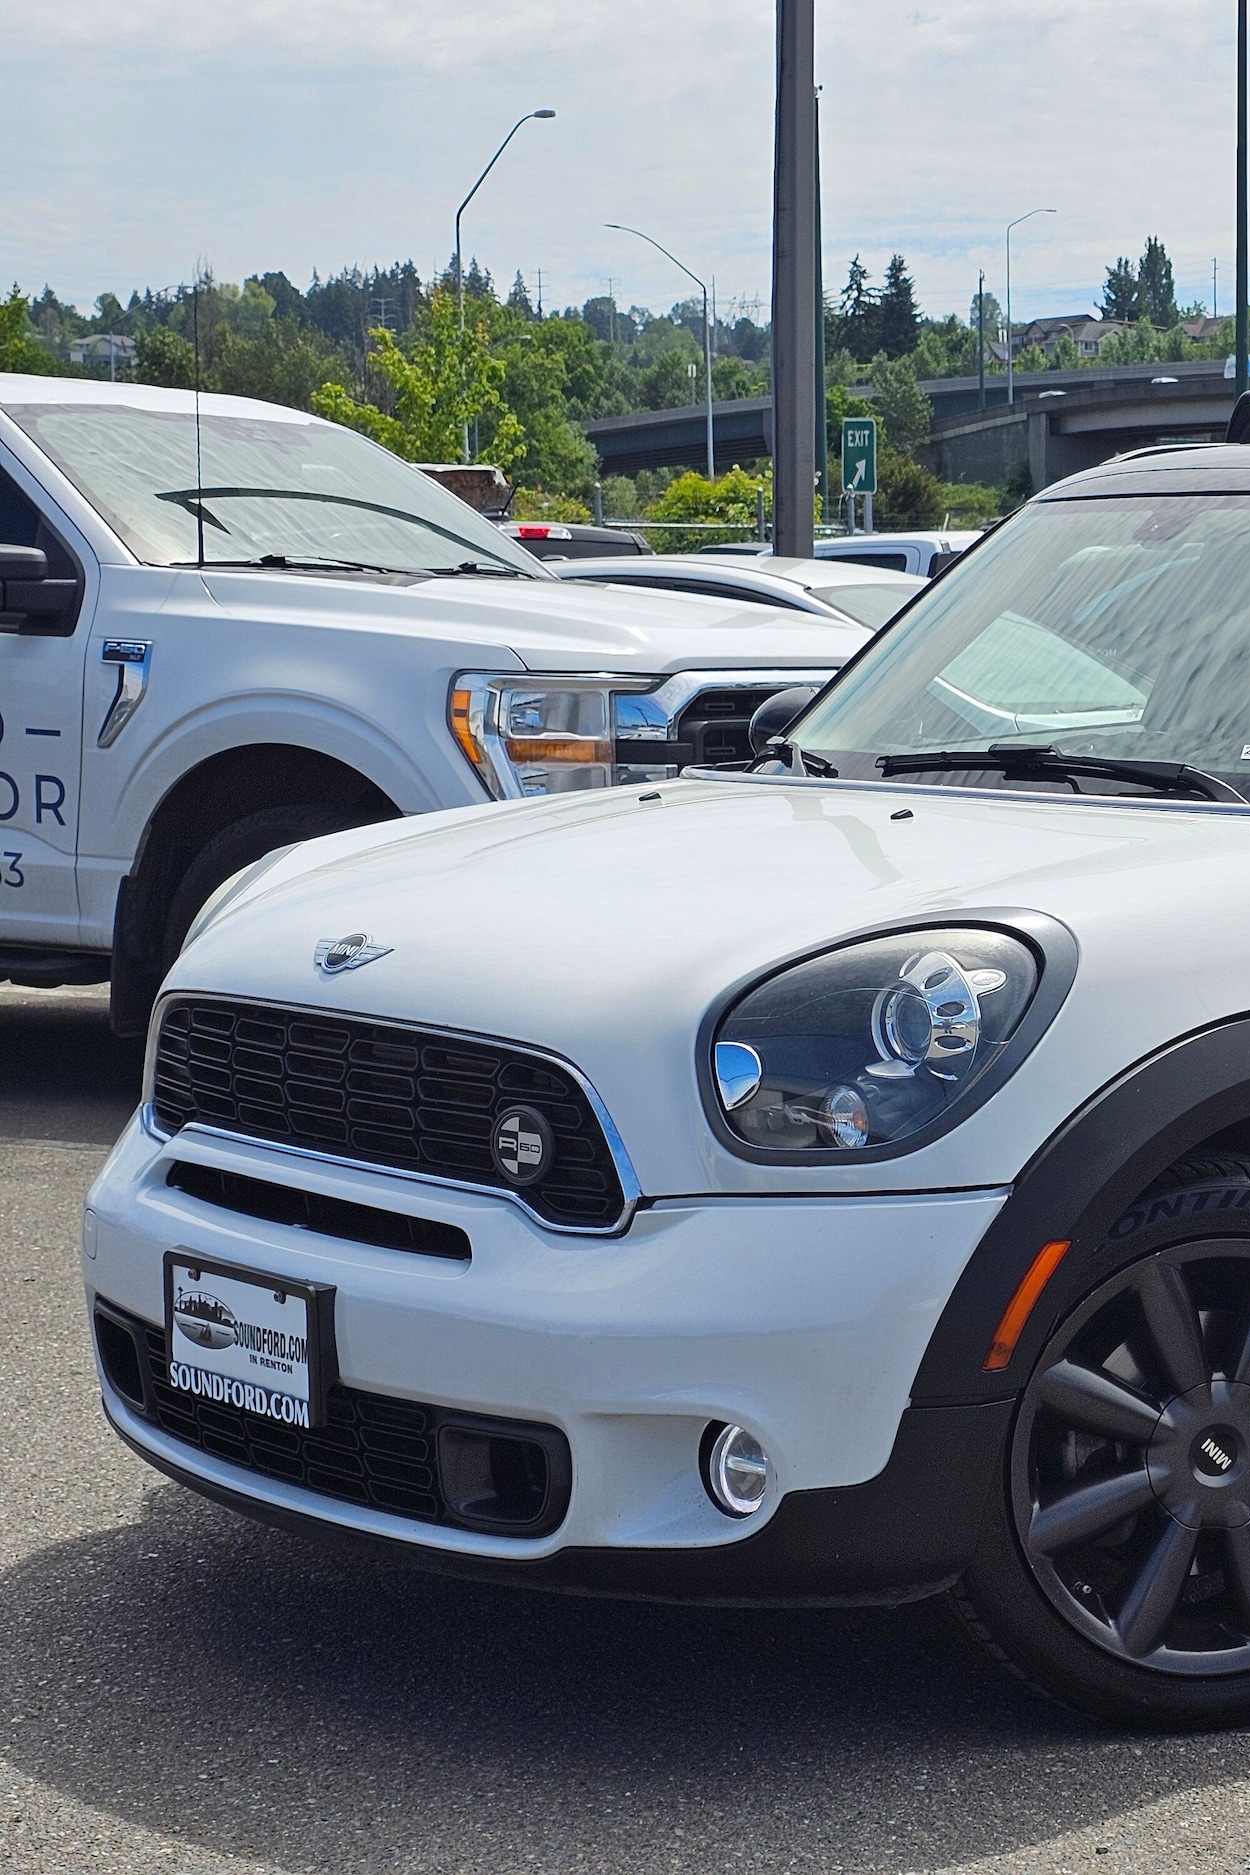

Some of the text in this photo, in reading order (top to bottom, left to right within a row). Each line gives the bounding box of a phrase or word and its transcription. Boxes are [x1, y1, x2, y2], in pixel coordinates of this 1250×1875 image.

[847, 430, 870, 448] EXIT
[329, 943, 360, 957] MINI
[233, 1320, 308, 1365] SOUNDFORD.COM
[249, 1354, 293, 1375] IN RENTON
[169, 1361, 310, 1429] SOUNDFORD.COM
[1200, 1438, 1232, 1471] MINI
